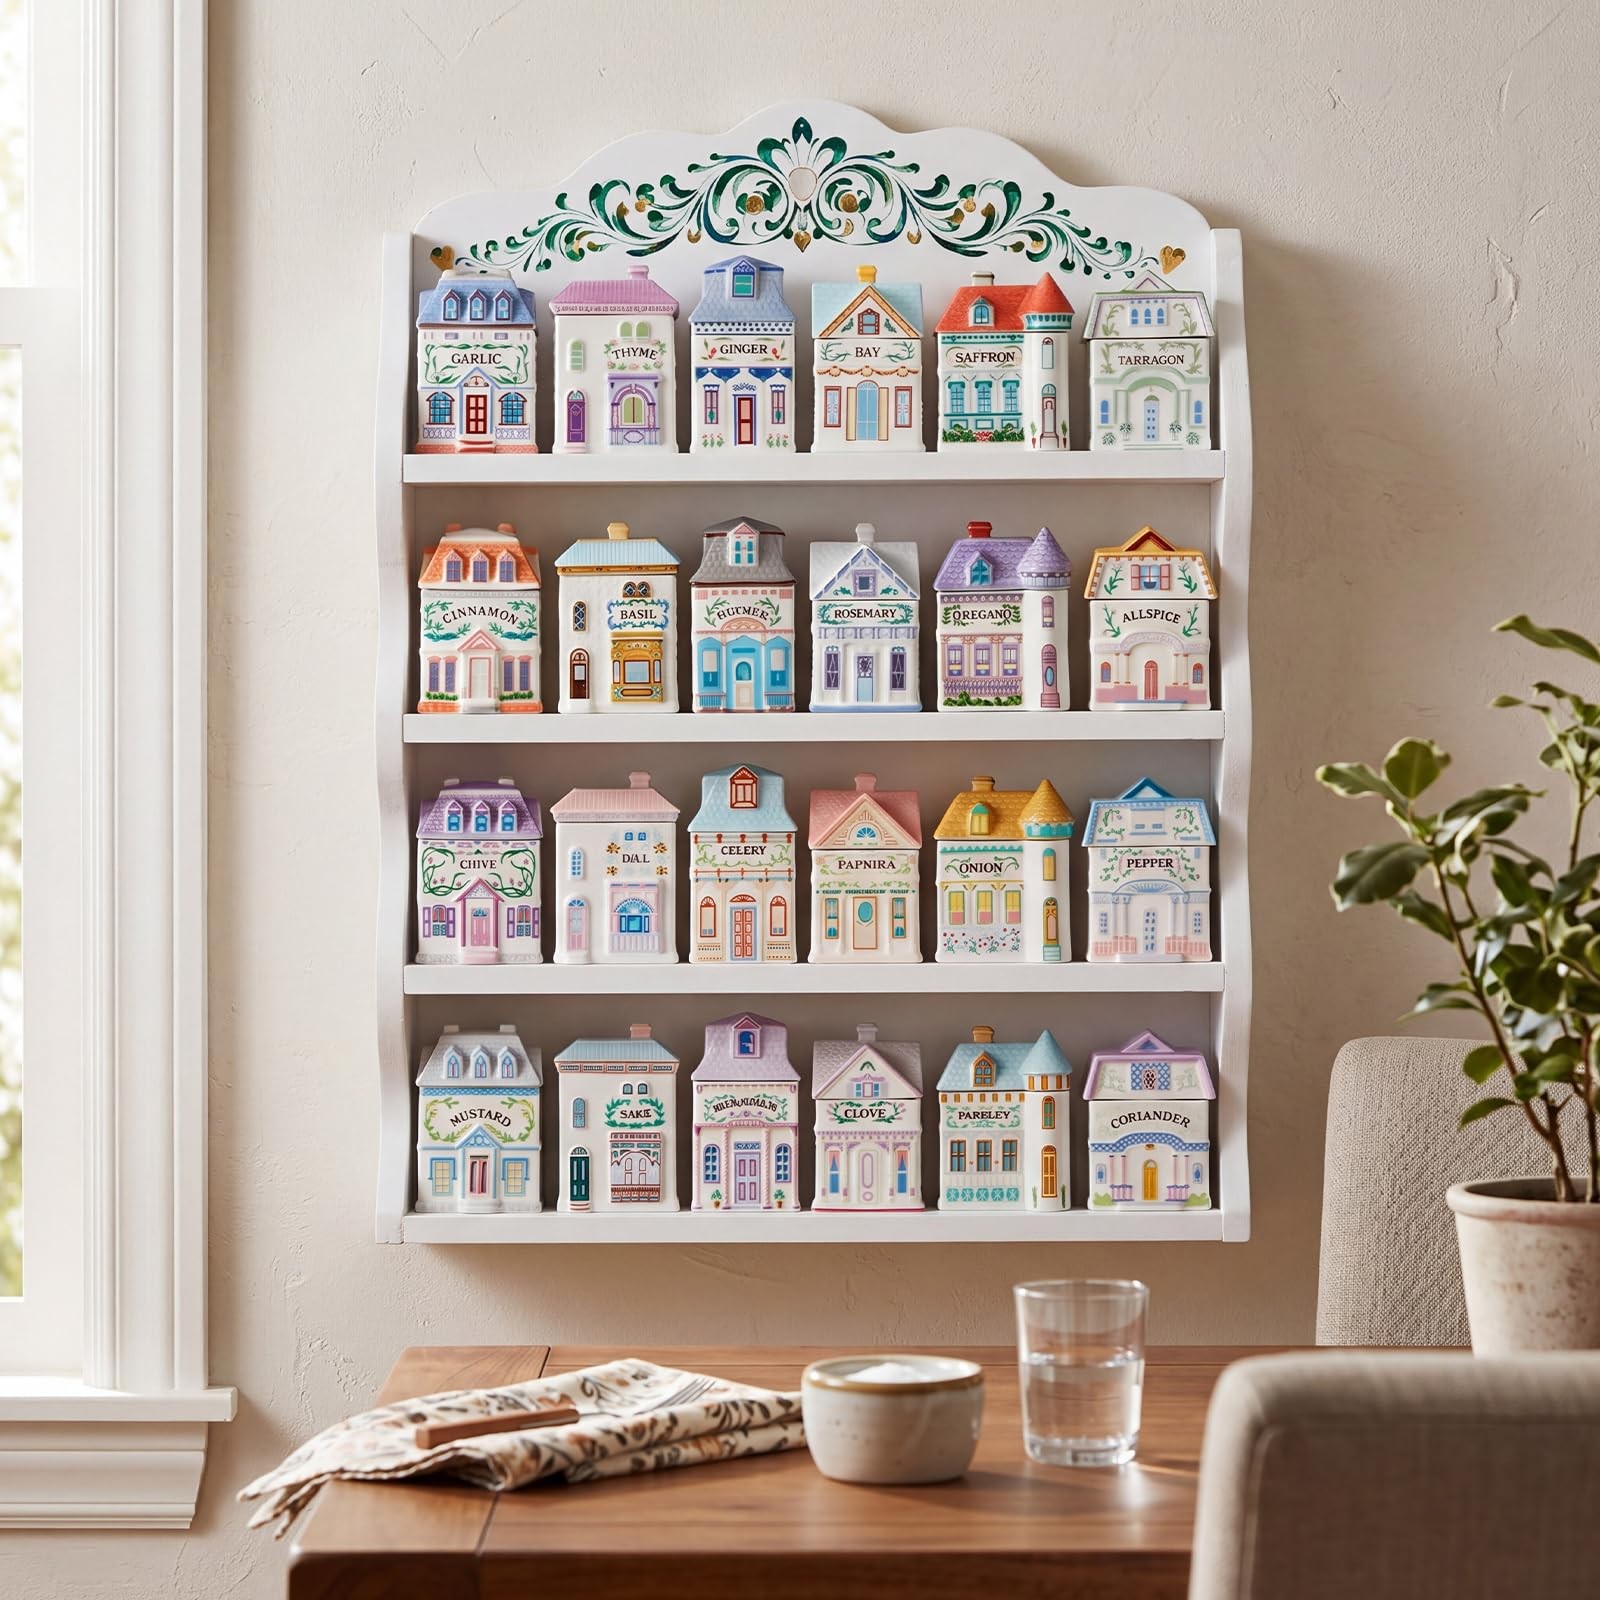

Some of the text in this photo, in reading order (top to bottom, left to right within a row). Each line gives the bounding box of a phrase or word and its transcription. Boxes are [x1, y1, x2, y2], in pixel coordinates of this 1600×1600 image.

[612, 346, 659, 360] THYME
[719, 343, 768, 355] GINGER
[854, 346, 880, 358] BAY
[451, 353, 502, 365] GARLIC
[954, 351, 1016, 364] SAFFRON
[1118, 353, 1185, 366] TARRAGON
[442, 606, 519, 625] CINNAMON
[620, 608, 657, 621] BASIL
[833, 607, 896, 619] ROSEMARY
[952, 608, 1012, 621] OREGANO
[1121, 608, 1181, 624] ALLSPICE
[720, 845, 767, 856] CELERY
[458, 859, 497, 870] CHIVE
[838, 860, 896, 870] PAPNIRA
[959, 861, 1004, 874] ONION
[1126, 857, 1173, 870] PEPPER
[449, 1108, 511, 1128] MUSTARD
[843, 1107, 887, 1120] CLOVE
[1109, 1110, 1191, 1129] CORIANDER
